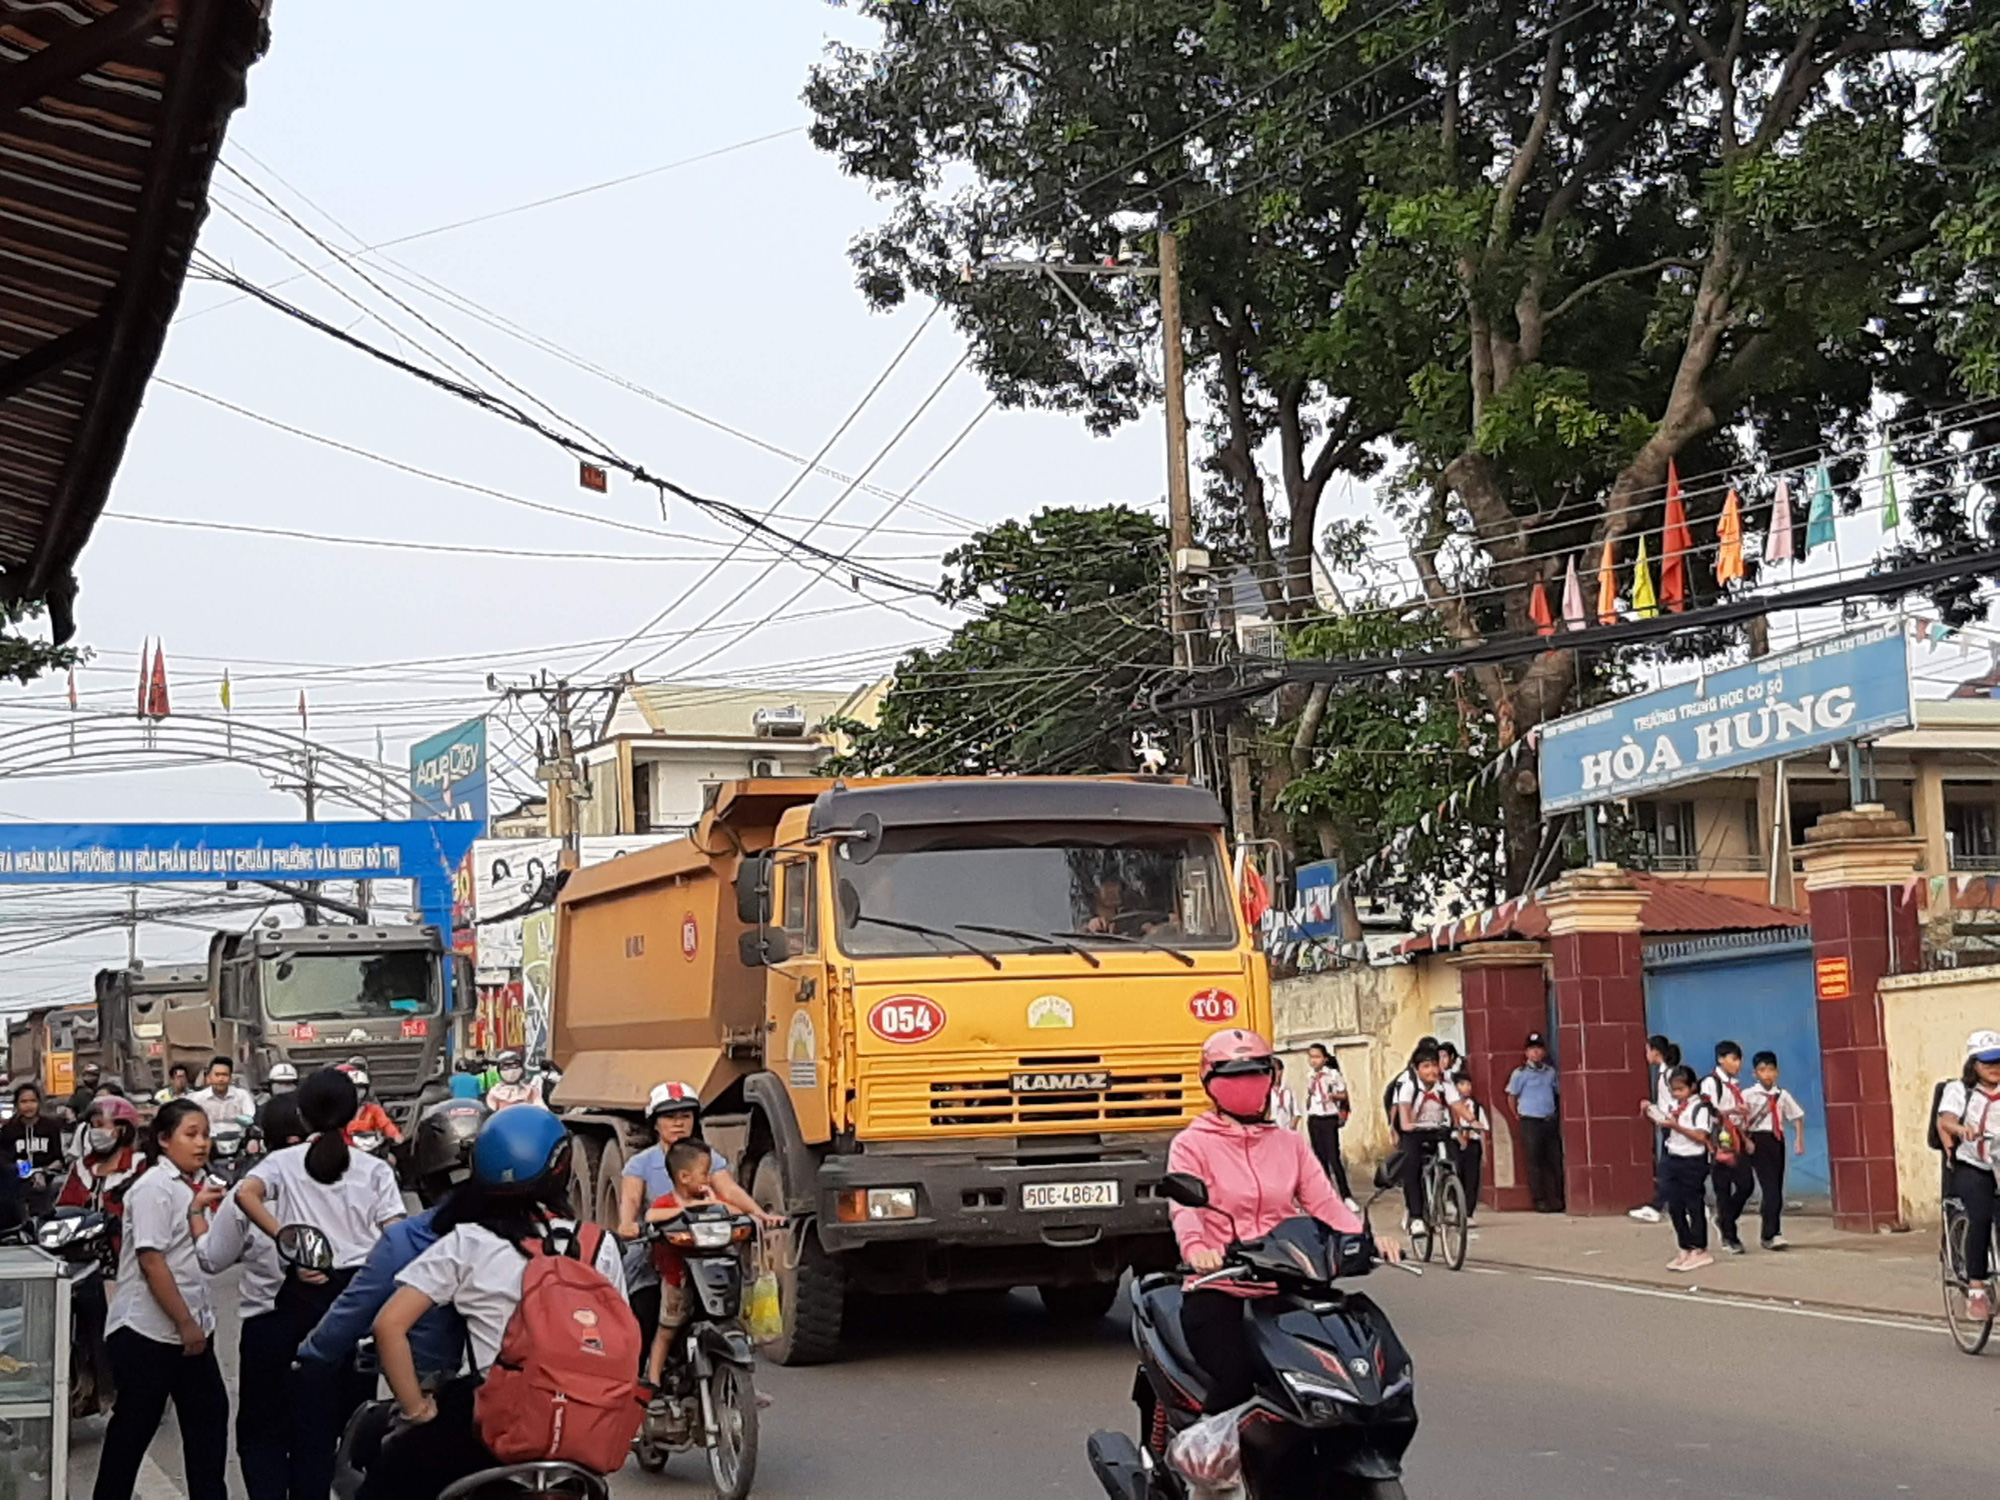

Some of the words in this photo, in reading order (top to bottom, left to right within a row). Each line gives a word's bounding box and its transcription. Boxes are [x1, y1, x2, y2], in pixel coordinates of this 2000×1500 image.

[1719, 687, 1744, 710] HỌC
[1580, 734, 1682, 790] HÒA
[1693, 685, 1857, 761] HƯNG
[1192, 988, 1220, 1017] TỔ
[882, 1005, 932, 1033] 054
[1013, 1074, 1107, 1090] KAMAZ
